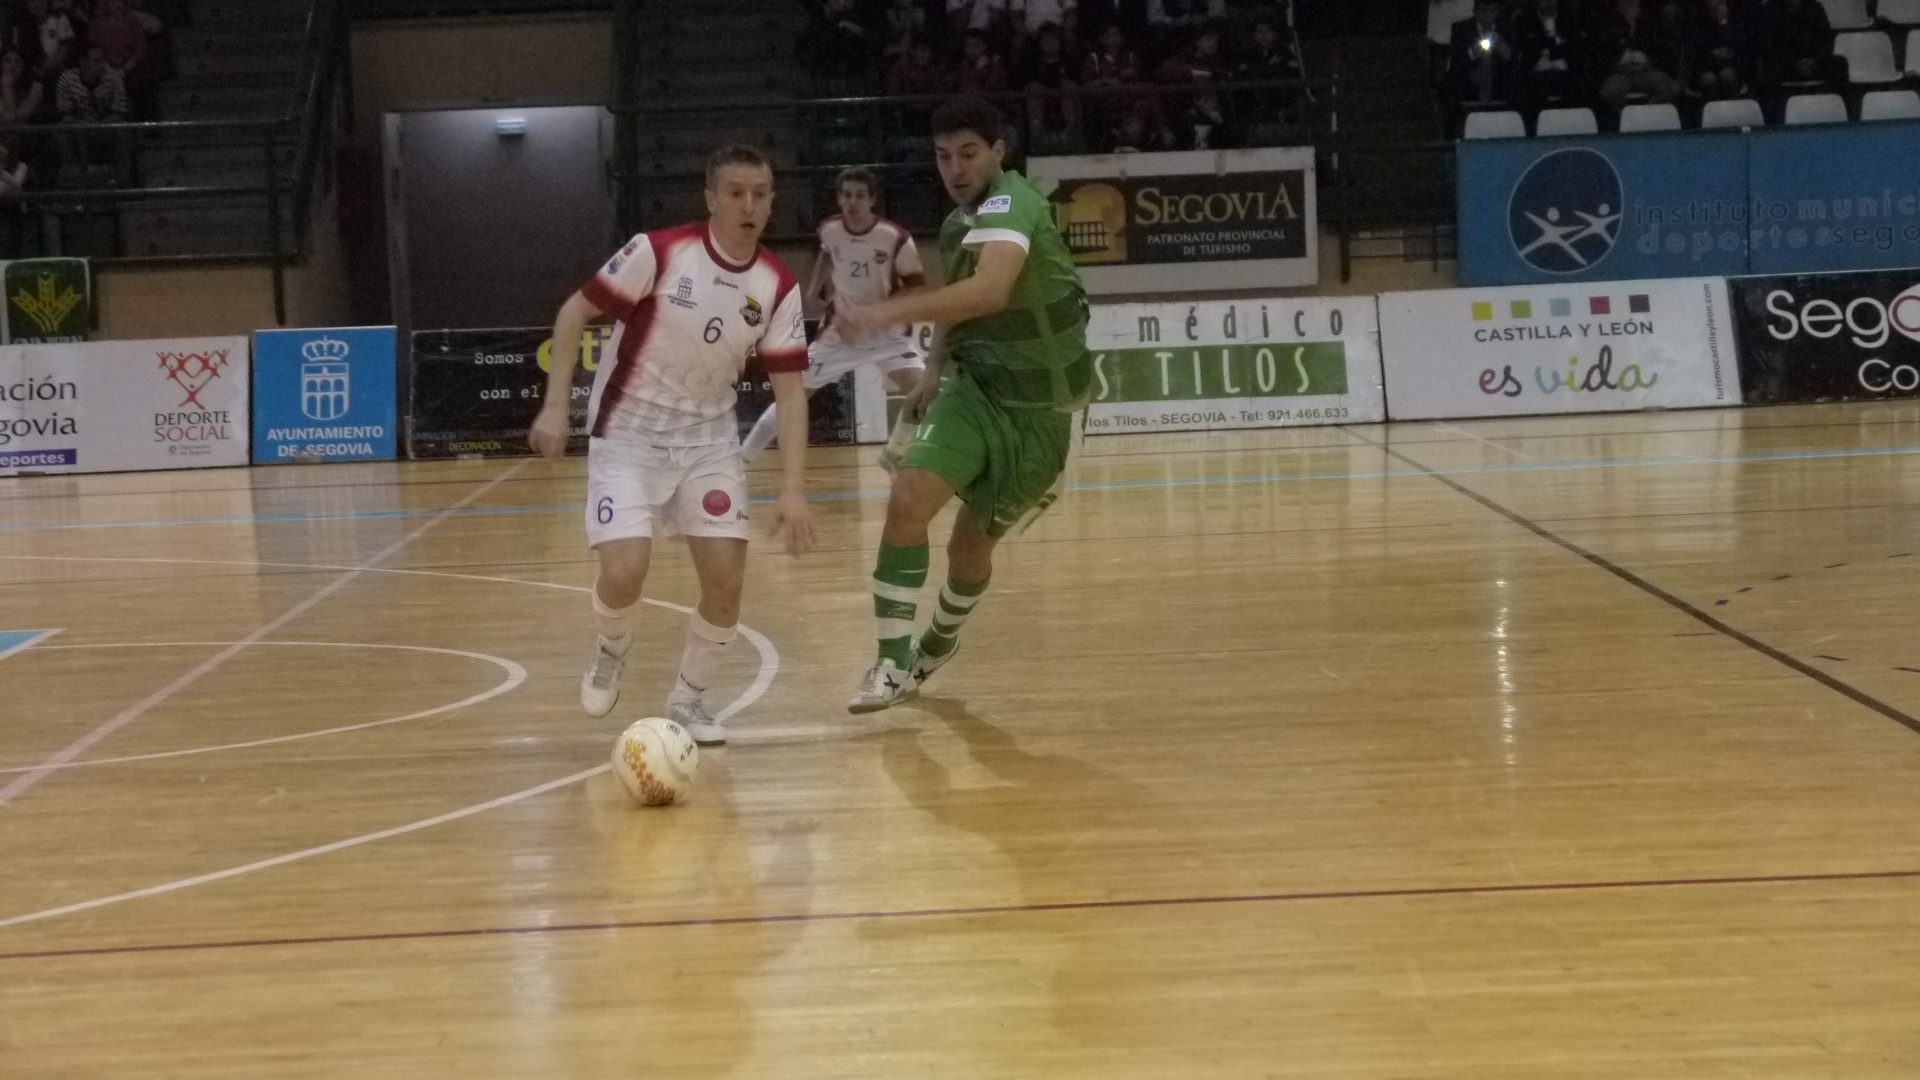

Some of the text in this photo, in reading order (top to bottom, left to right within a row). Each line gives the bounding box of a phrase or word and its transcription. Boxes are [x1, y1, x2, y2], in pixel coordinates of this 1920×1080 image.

[1134, 182, 1298, 226] SEGOVIA
[1637, 198, 1788, 224] instituto
[1147, 229, 1287, 245] PATRONATO PROVINCIAL
[1183, 243, 1251, 255] DE TURISMO
[850, 261, 869, 278] 21
[703, 316, 724, 344] 6
[1137, 304, 1344, 343] médico
[1474, 317, 1655, 343] CASTILLA Y LEÓN
[1702, 282, 1725, 400] turismocastillayleon.com
[474, 352, 524, 365] Somos
[1155, 346, 1310, 396] TILOS
[1478, 344, 1658, 398] es vida
[480, 388, 511, 400] con
[520, 385, 540, 398] el
[154, 411, 230, 426] DEPORTE
[1113, 414, 1149, 427] Tilos
[1160, 412, 1227, 425] SEGOVIA
[1238, 410, 1264, 422] Tel:
[1267, 407, 1350, 421] 921.466.633
[154, 425, 231, 442] SOCIAL
[266, 426, 384, 441] AYUNTAMIENTO
[305, 442, 373, 456] SEGOVIA
[596, 497, 614, 525] 6
